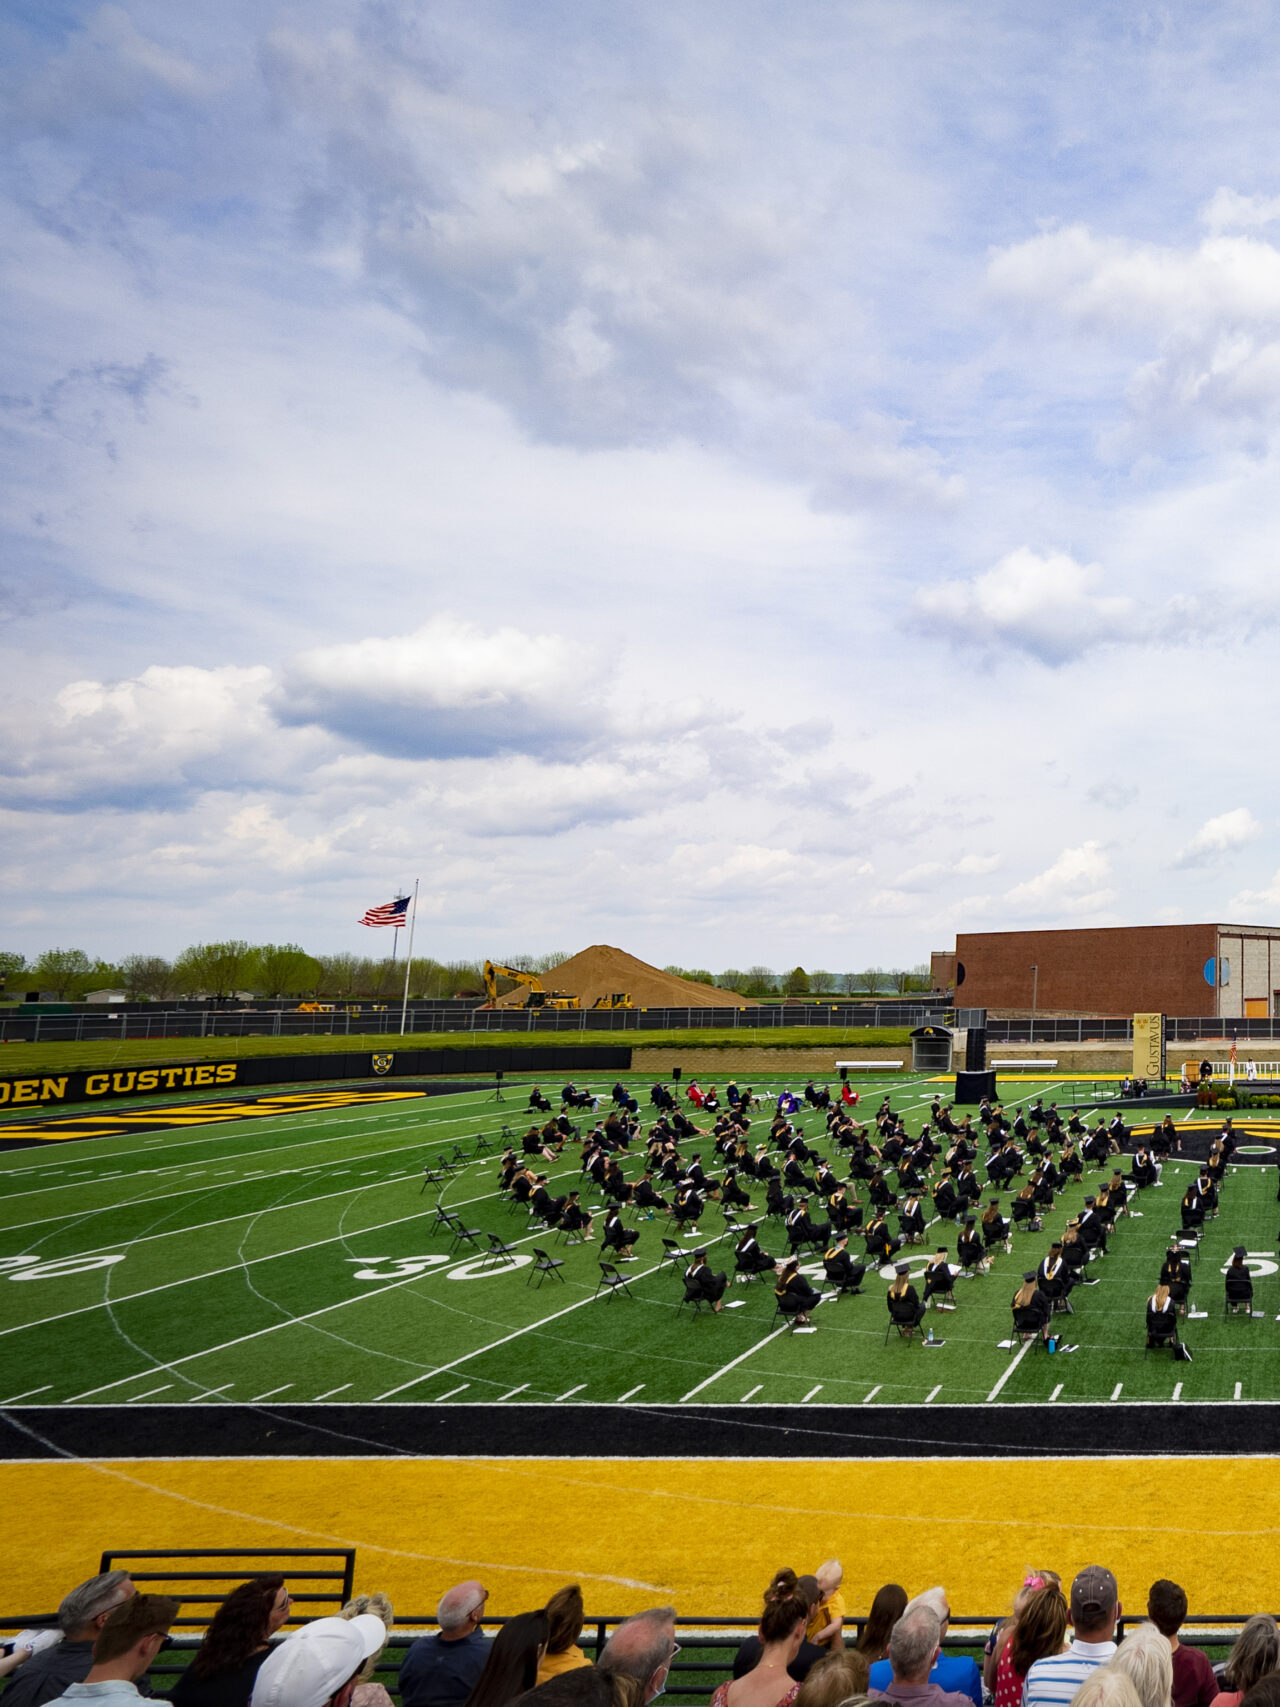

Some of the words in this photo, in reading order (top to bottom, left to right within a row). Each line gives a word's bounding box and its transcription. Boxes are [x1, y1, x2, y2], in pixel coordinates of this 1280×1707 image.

[1146, 1015, 1160, 1076] GUSTAVUS
[85, 1064, 237, 1095] GUSTIES
[354, 1255, 534, 1280] 30
